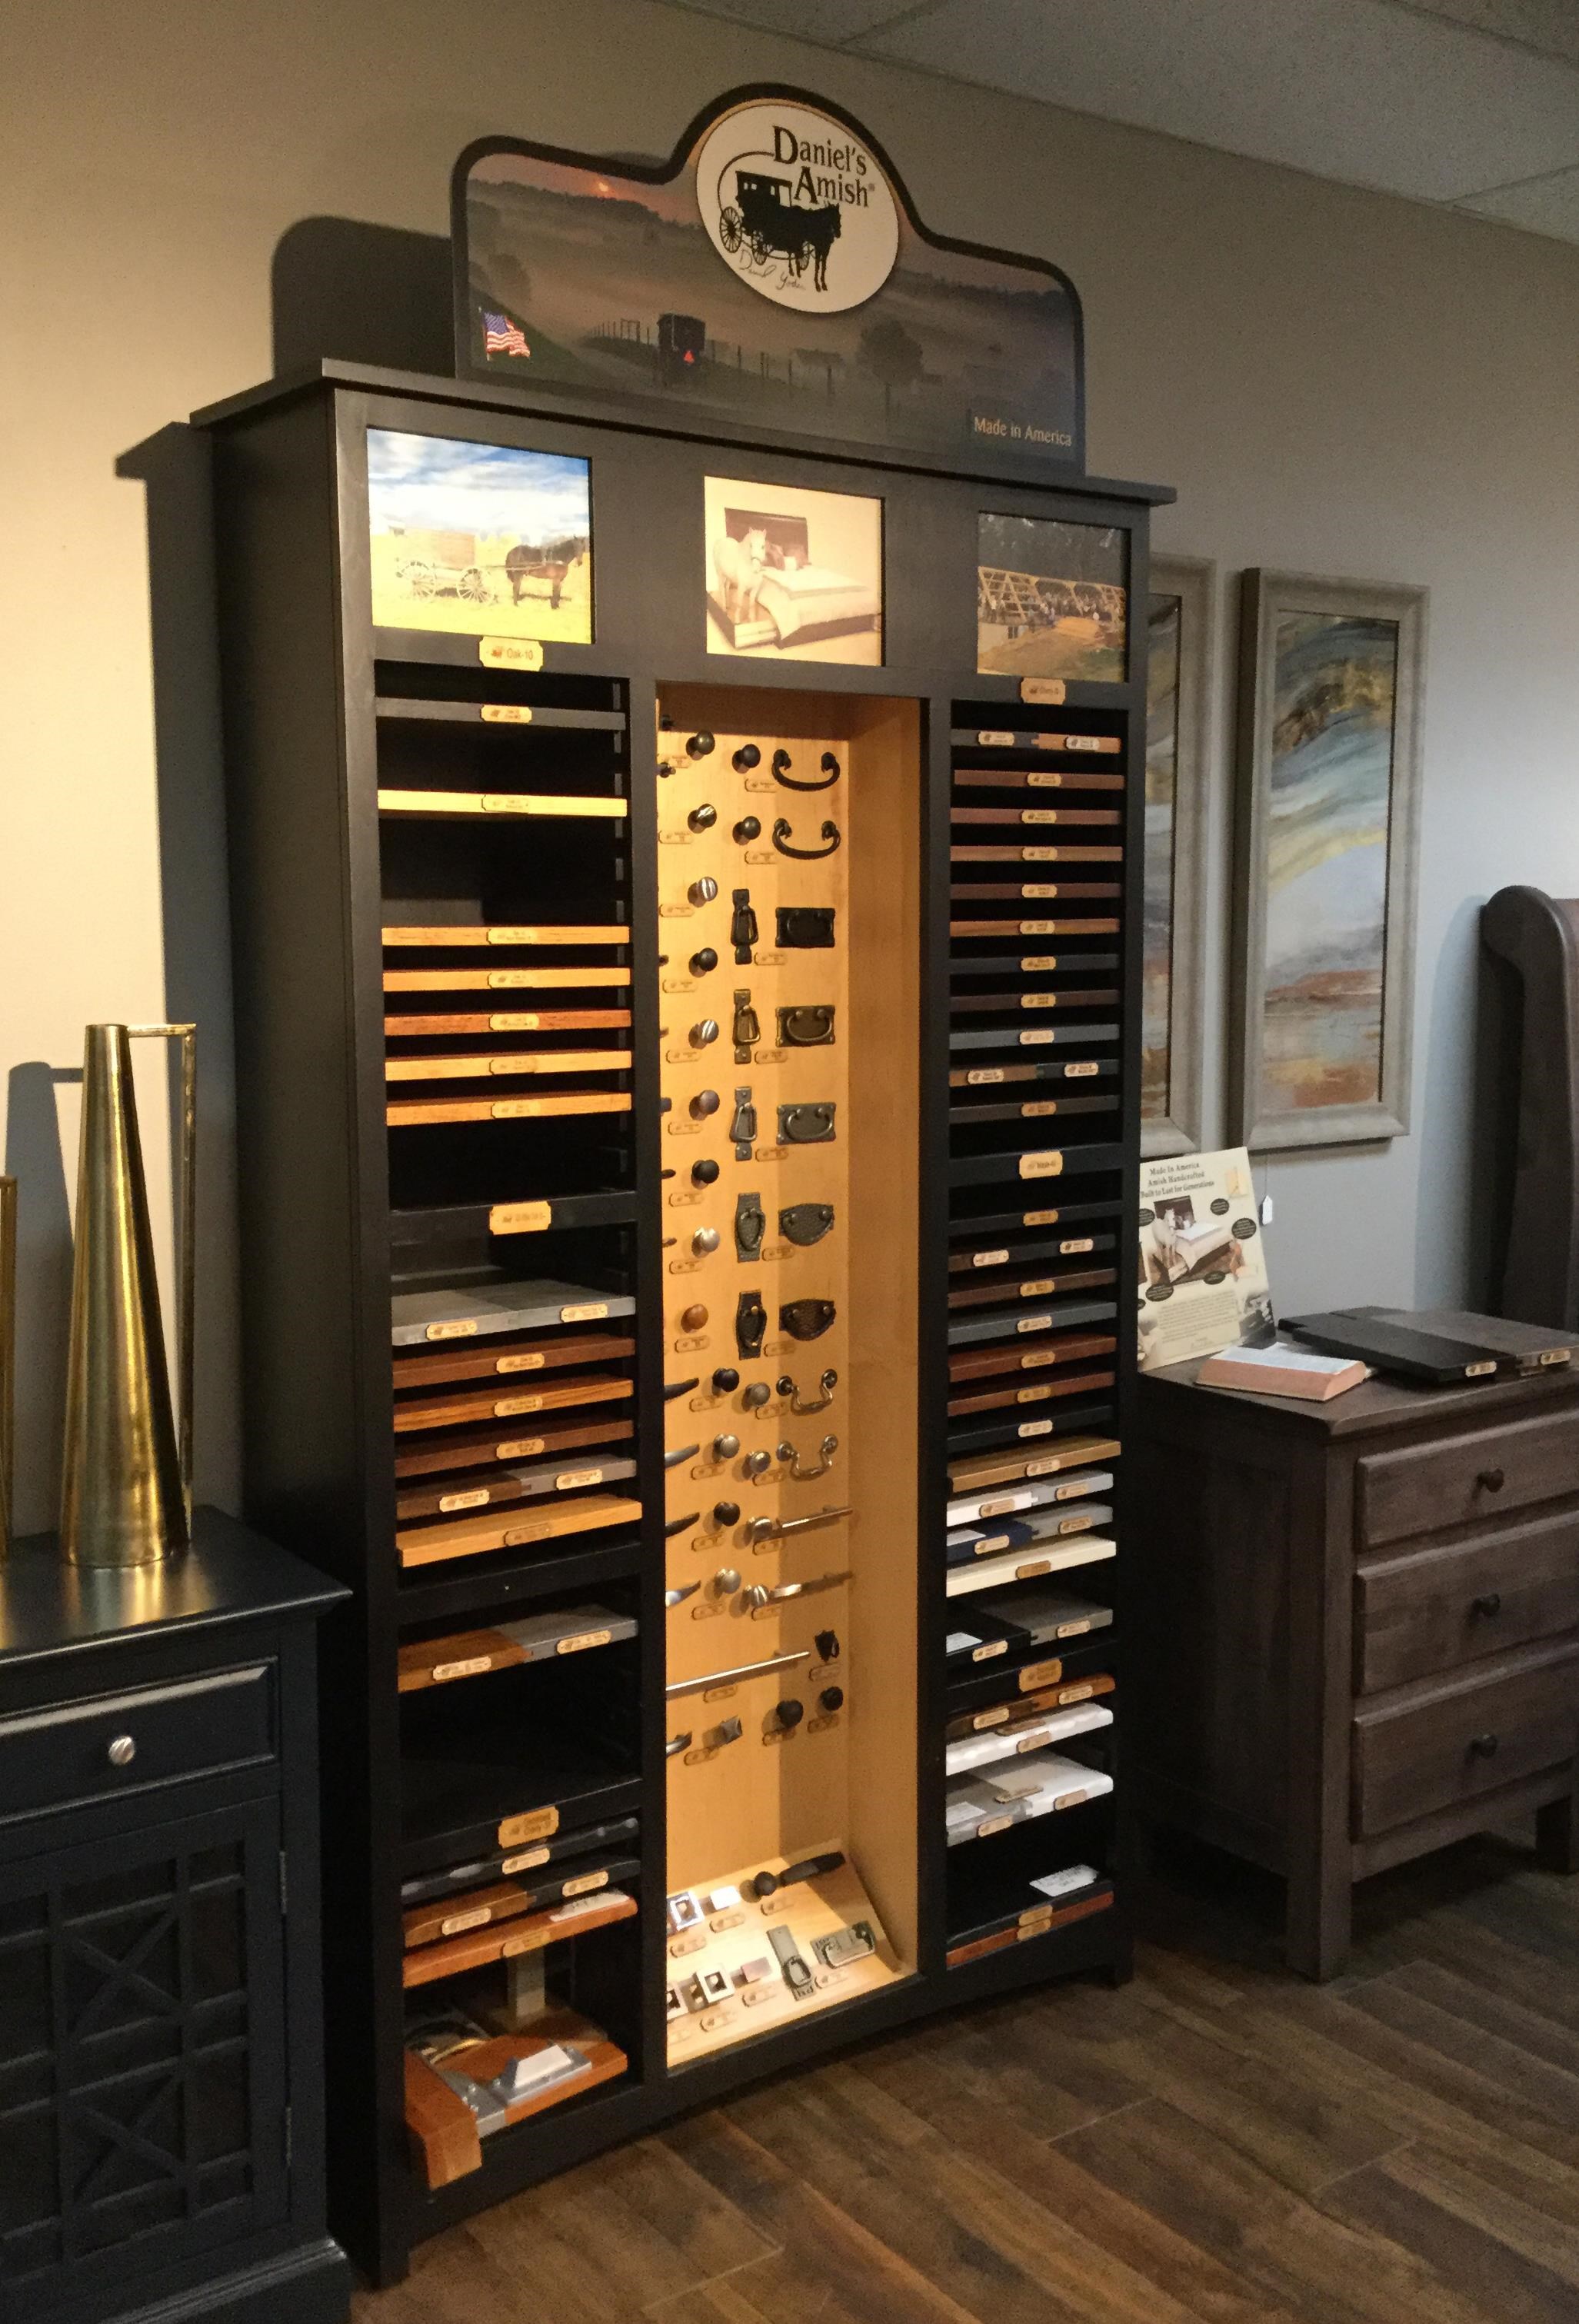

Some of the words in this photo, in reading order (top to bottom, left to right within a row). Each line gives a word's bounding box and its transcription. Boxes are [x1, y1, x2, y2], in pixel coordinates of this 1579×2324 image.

[772, 125, 868, 176] Daniel's
[793, 165, 868, 208] Amish
[974, 416, 1007, 436] Made
[1010, 423, 1021, 439] in
[1024, 425, 1072, 447] America
[1177, 1162, 1200, 1171] America
